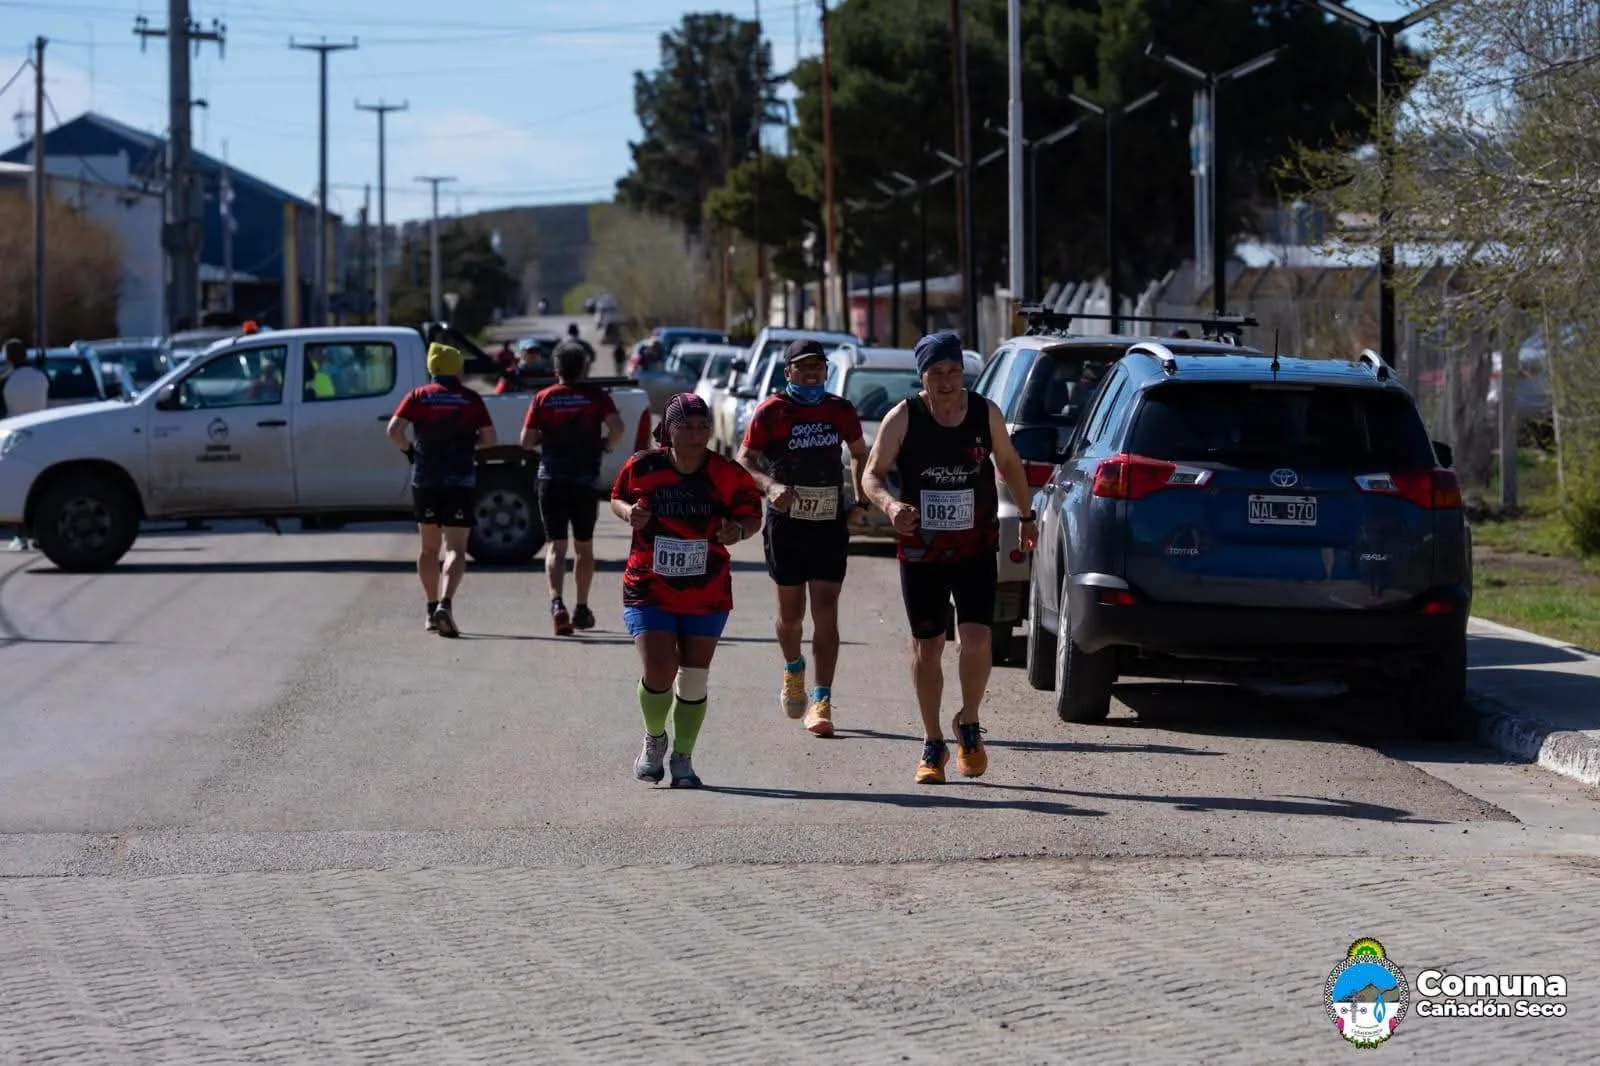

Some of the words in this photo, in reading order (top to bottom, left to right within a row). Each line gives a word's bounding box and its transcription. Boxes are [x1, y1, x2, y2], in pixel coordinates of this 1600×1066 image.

[792, 424, 823, 436] CROSS
[935, 475, 968, 485] TEAM
[798, 499, 819, 512] 137
[927, 503, 956, 521] 082
[1251, 502, 1278, 519] NAL
[1287, 503, 1314, 520] 970
[1168, 547, 1200, 556] TOYOTA
[659, 550, 686, 567] 018
